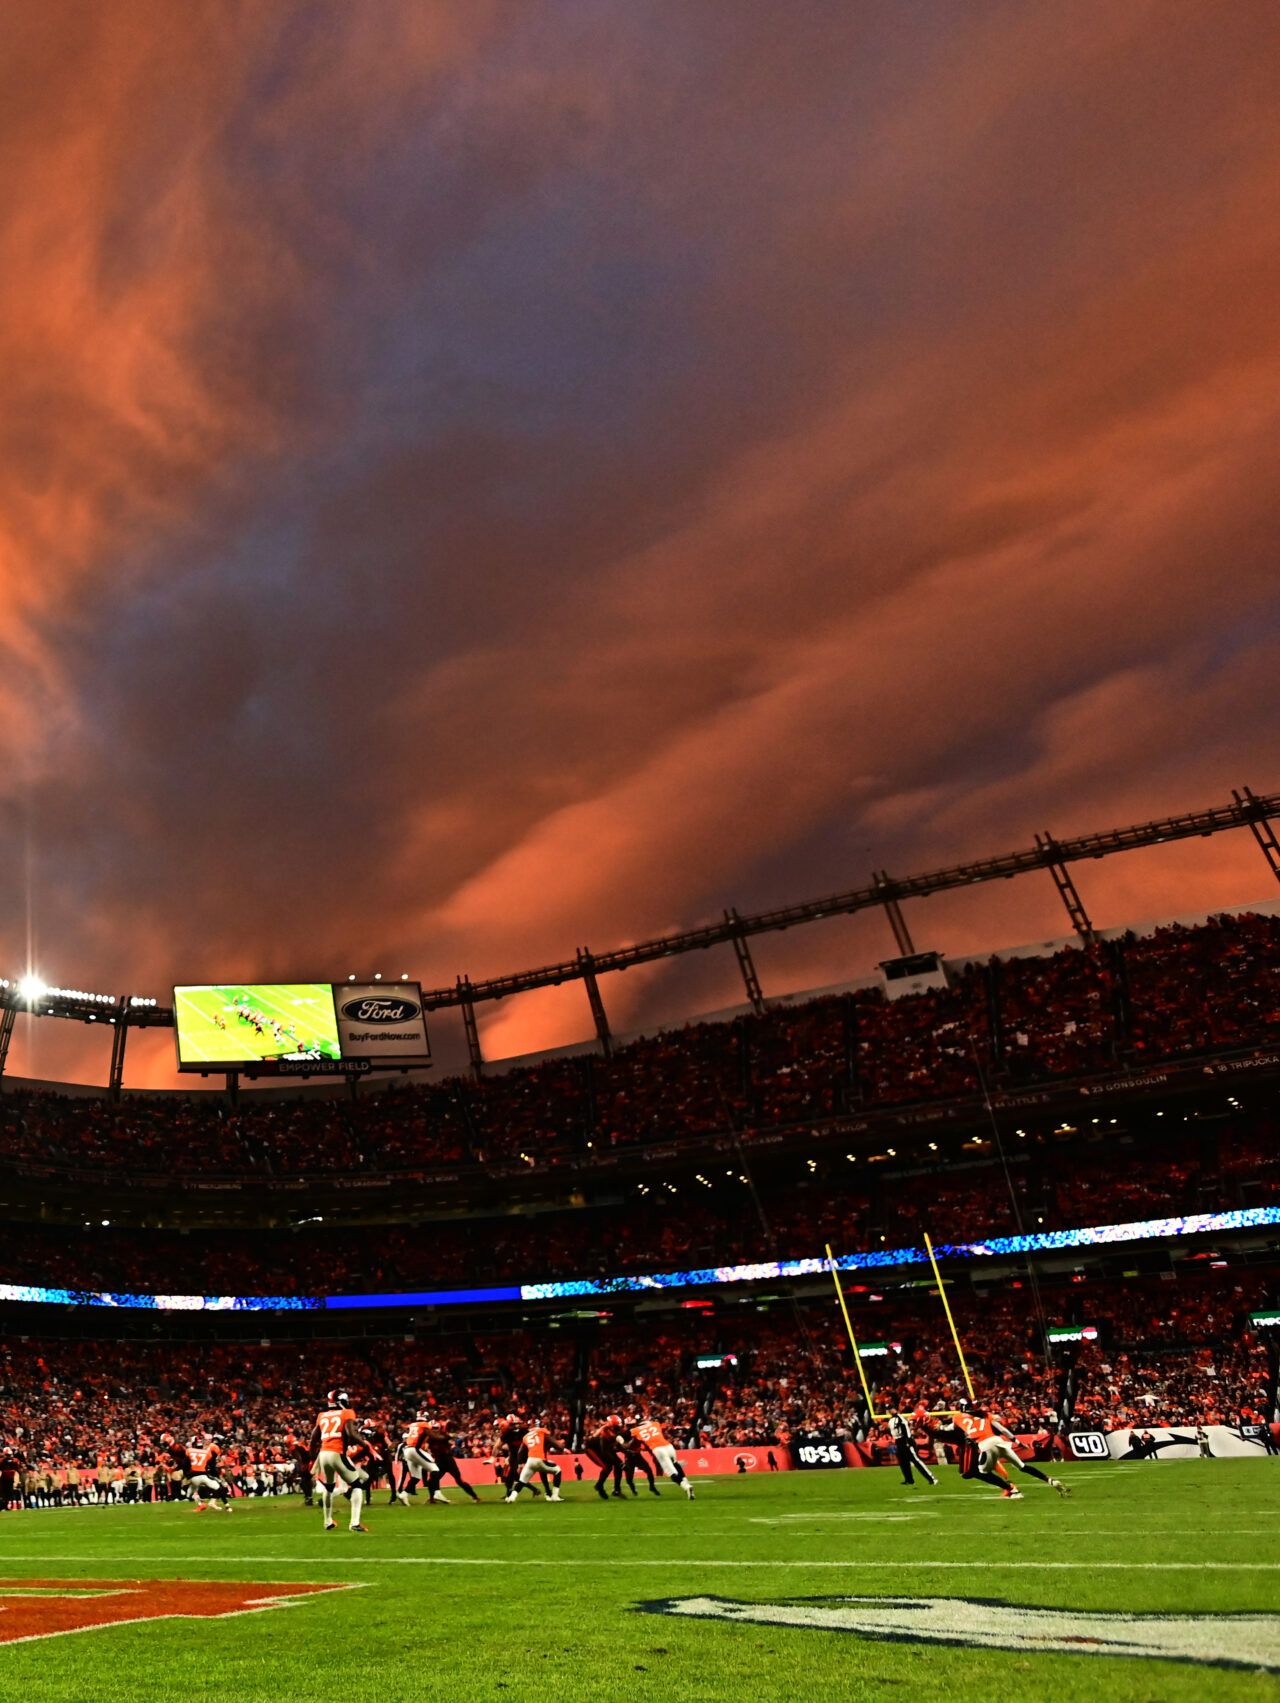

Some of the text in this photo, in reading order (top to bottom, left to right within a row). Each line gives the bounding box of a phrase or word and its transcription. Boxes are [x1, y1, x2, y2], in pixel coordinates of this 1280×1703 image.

[358, 1000, 404, 1019] Ford
[348, 1032, 420, 1043] BuyFordNow.com
[279, 1061, 369, 1072] EMPOWER FIELD
[320, 1415, 342, 1440] 22
[639, 1426, 660, 1441] 52
[962, 1418, 986, 1434] 27
[1074, 1435, 1102, 1453] 40
[190, 1452, 207, 1466] 37
[799, 1445, 842, 1463] 10:56
